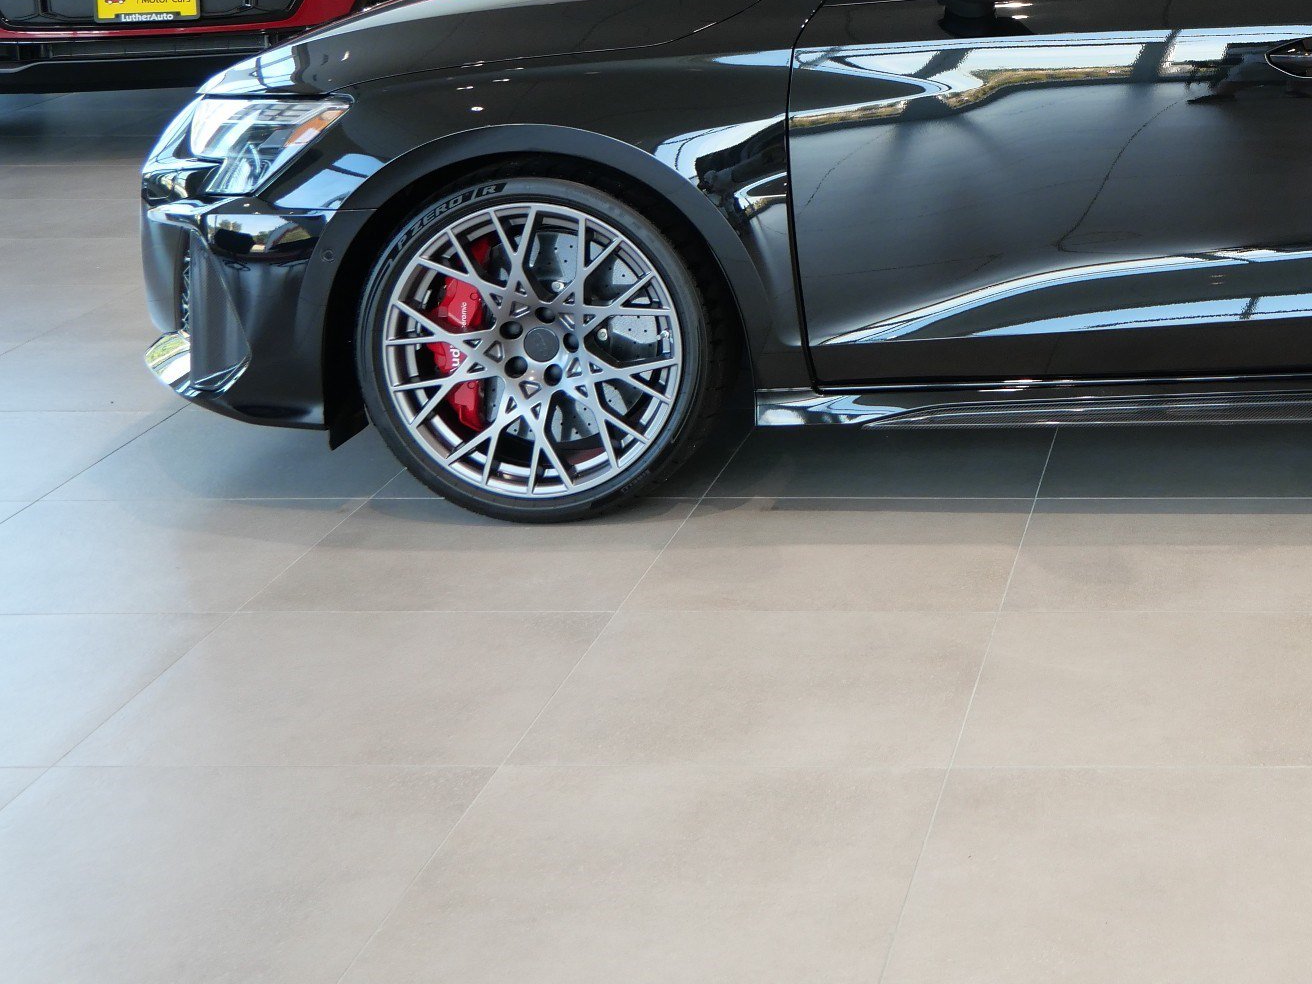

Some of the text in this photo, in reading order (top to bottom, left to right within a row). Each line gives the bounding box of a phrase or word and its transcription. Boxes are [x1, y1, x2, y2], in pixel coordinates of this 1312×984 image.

[121, 13, 174, 22] LutherAuto
[397, 184, 497, 252] P ZERO R
